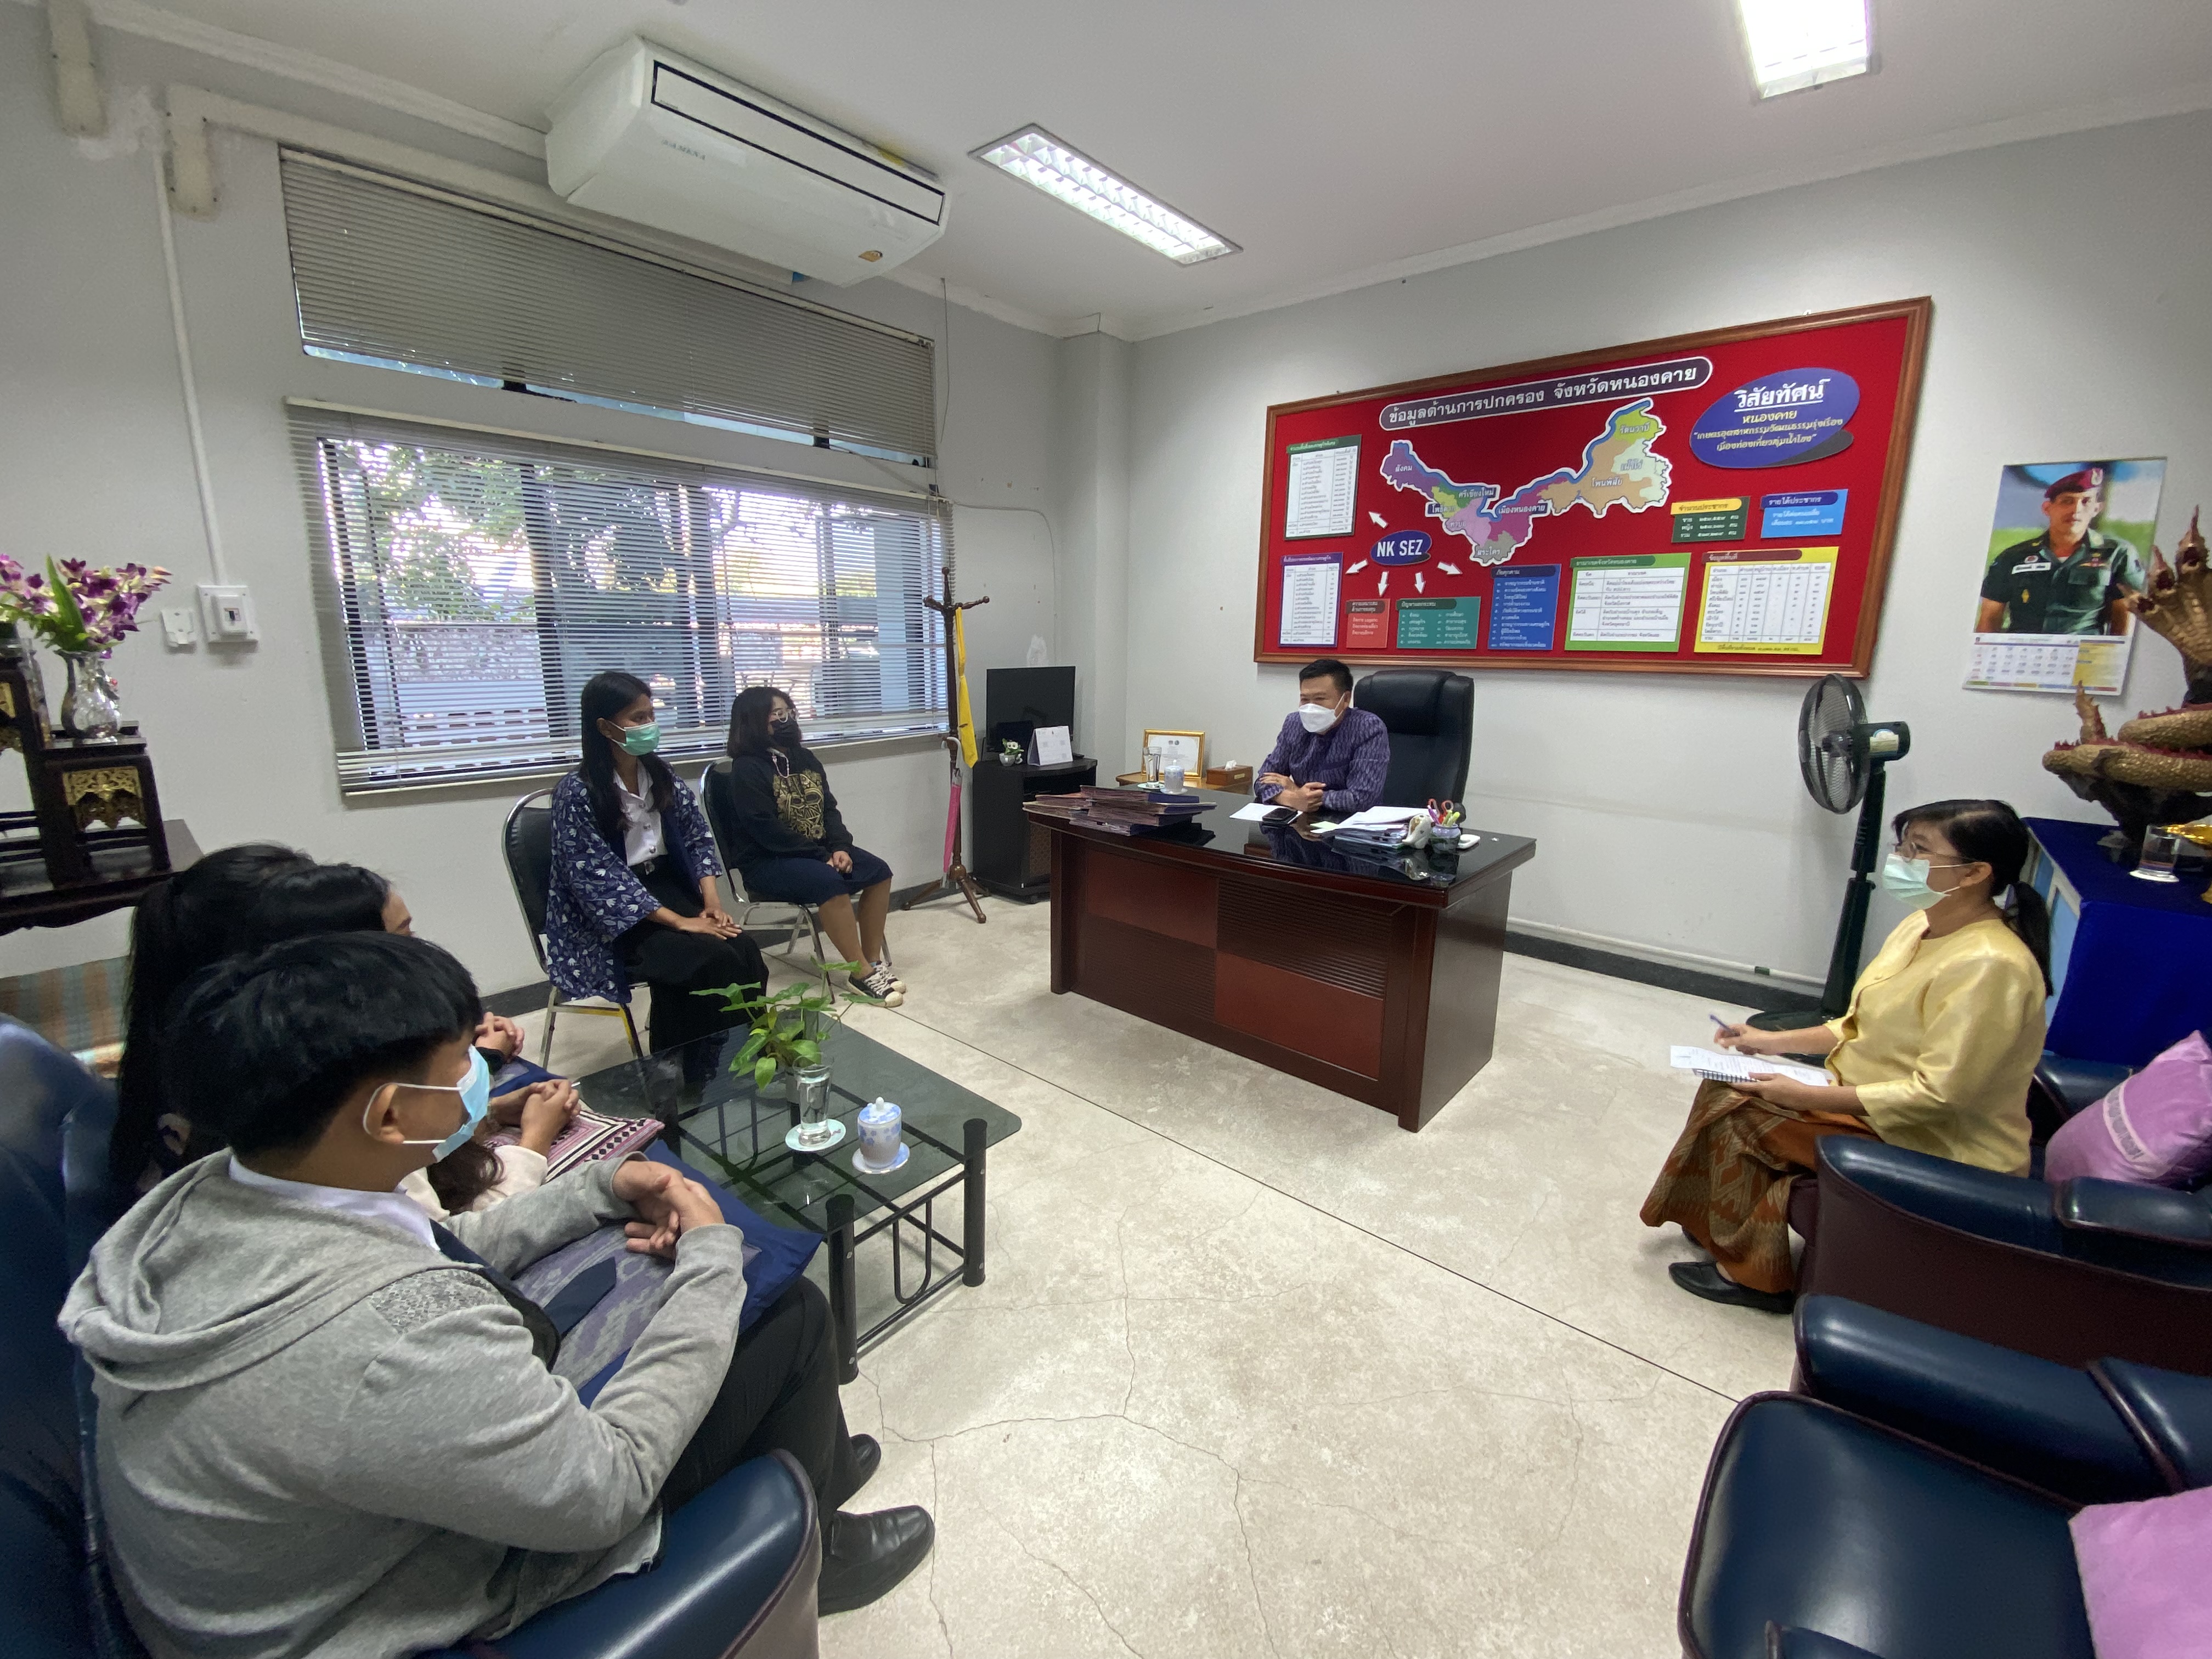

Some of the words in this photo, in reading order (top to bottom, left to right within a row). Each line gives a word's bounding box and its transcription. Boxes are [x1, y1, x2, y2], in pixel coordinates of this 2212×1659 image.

[1389, 390, 1545, 426] ข้อมูลด้านการปกครอง
[1553, 365, 1697, 399] จังหวัดหนองคาย
[1734, 379, 1831, 409] วิสัยทัศน์
[1742, 410, 1798, 425] หนองคาย
[1620, 422, 1651, 434] รัตนวาปี
[1395, 464, 1413, 472] สังคม
[1592, 477, 1623, 488] โพนพิสัย
[1458, 488, 1494, 498] ศรีเชียงใหม่
[1769, 496, 1822, 505] รายได้ประชากร
[1498, 504, 1545, 514] เมืองหนองคาย
[1679, 503, 1728, 511] จำนวนประชากร
[1377, 542, 1395, 557] NK
[1400, 539, 1424, 556] SEZ
[1477, 548, 1500, 556] สระใคร
